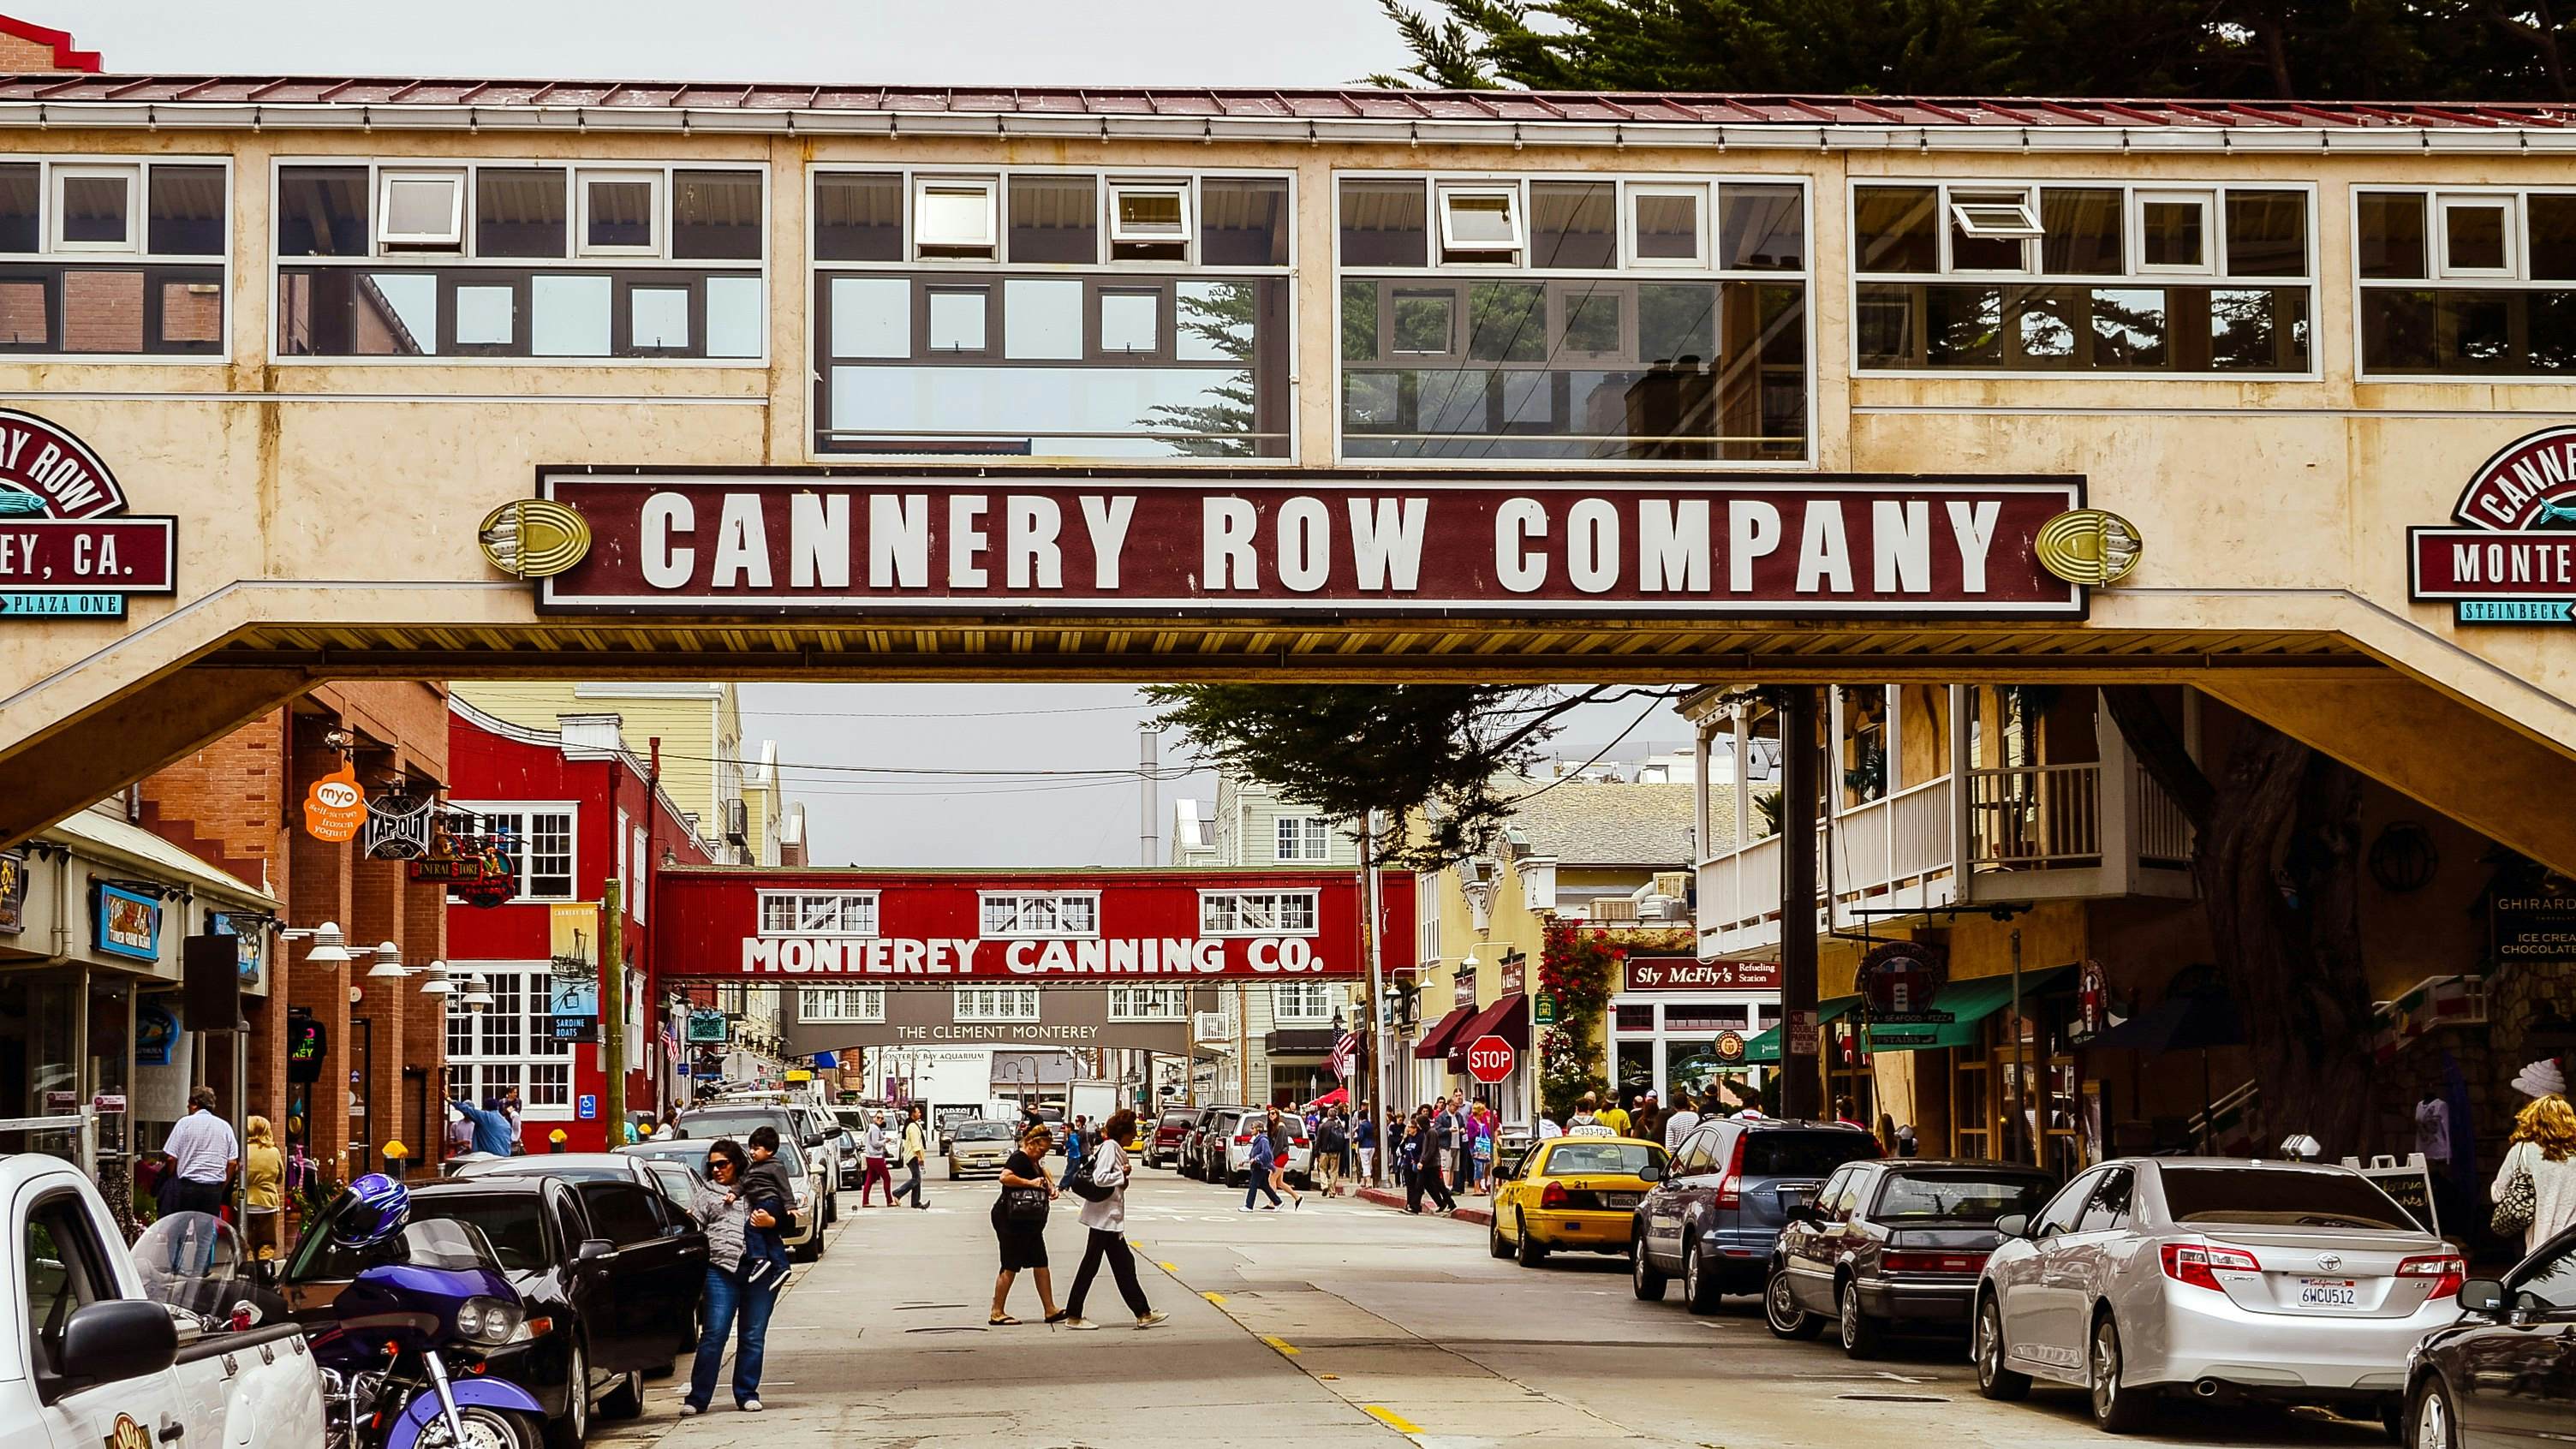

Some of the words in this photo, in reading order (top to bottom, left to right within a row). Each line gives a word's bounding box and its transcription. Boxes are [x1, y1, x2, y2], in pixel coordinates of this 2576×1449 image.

[27, 442, 103, 513] ROW
[641, 492, 1136, 589] CANNERY
[1202, 496, 1428, 593] ROW
[1494, 498, 2002, 593] COMPANY
[74, 534, 133, 575] CA.
[14, 596, 69, 612] PLAZA
[80, 595, 116, 612] ONE
[2466, 603, 2560, 619] STEINBECK
[321, 788, 355, 805] myo
[308, 804, 357, 818] self-serve
[321, 818, 354, 828] frozen
[314, 825, 347, 838] yogurt
[365, 805, 432, 856] TAPOUT
[412, 862, 449, 877] GENERAL
[451, 862, 479, 877] STORE
[2498, 898, 2576, 909] GHIRARD
[2519, 933, 2540, 943] ICE
[2542, 933, 2576, 943] CREA
[742, 938, 981, 973] MONTEREY
[1005, 938, 1225, 973] CANNING
[1247, 938, 1324, 972] CO.
[1738, 963, 1775, 973] Refueling
[1636, 967, 1663, 986] Sly
[1667, 967, 1732, 986] McFly's
[557, 1019, 585, 1028] SARDINE
[1792, 1014, 1803, 1023] NO
[557, 1029, 577, 1037] BOATS
[897, 1026, 927, 1039] THE
[933, 1026, 1005, 1039] CLEMENT
[1013, 1026, 1099, 1039] MONTEREY
[1471, 1051, 1511, 1068] STOP
[1581, 1127, 1613, 1136] 333-1234
[1574, 1180, 1588, 1190] 21
[2310, 1278, 2343, 1288] California
[2302, 1288, 2354, 1304] 6WCU512
